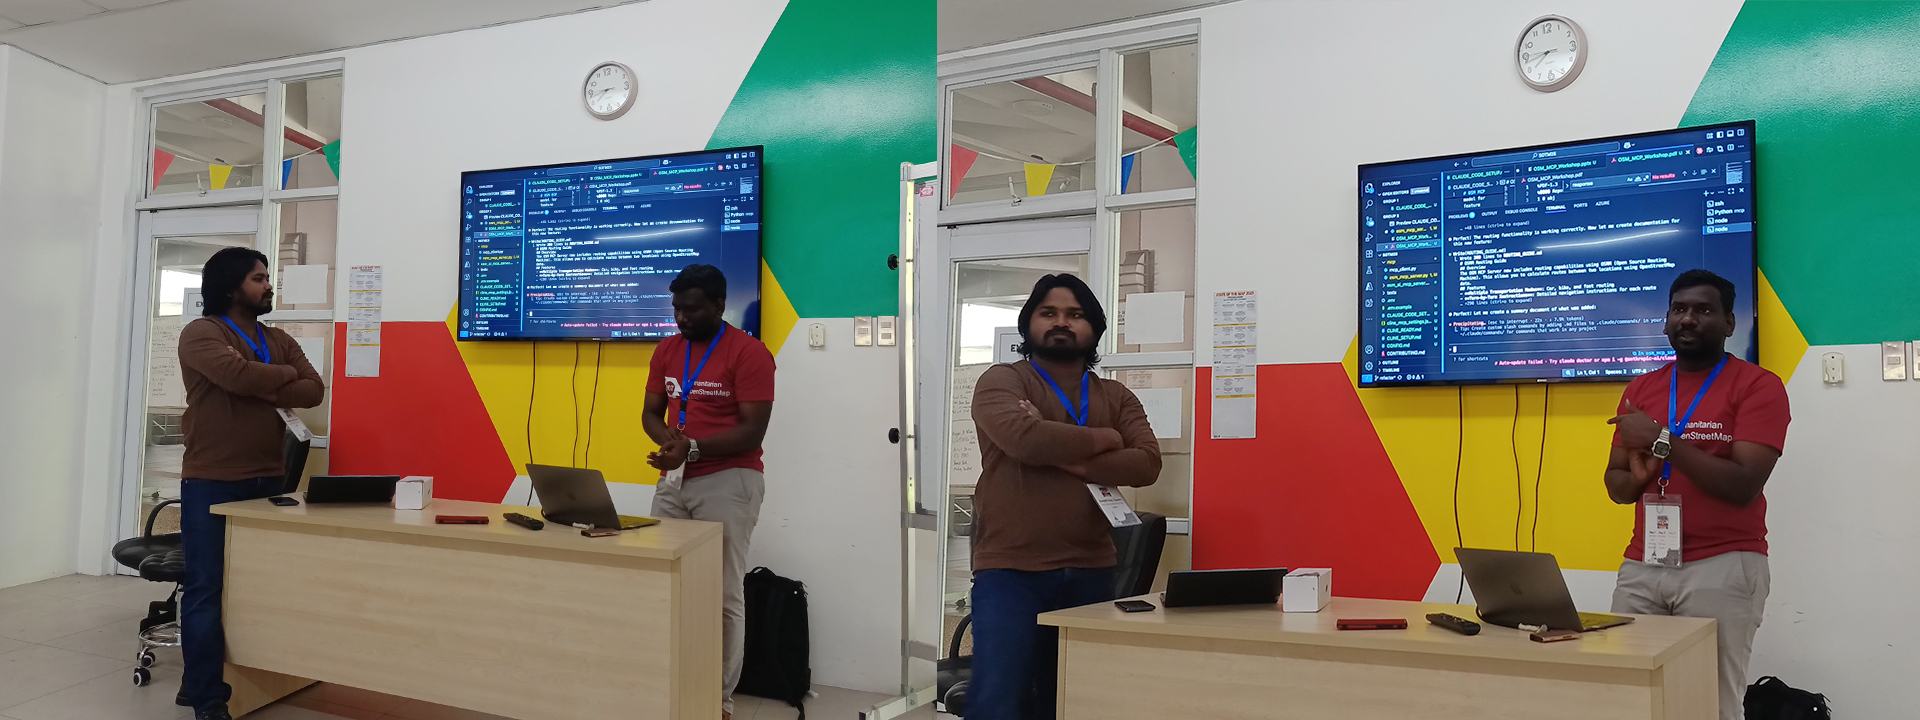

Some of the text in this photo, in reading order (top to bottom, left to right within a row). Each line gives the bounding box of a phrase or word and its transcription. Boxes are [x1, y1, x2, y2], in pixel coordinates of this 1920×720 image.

[1542, 22, 1552, 34] 12
[1568, 40, 1576, 52] 3
[1522, 52, 1530, 64] 9
[603, 68, 611, 76] 12
[1548, 70, 1556, 80] 6
[624, 80, 630, 90] 3
